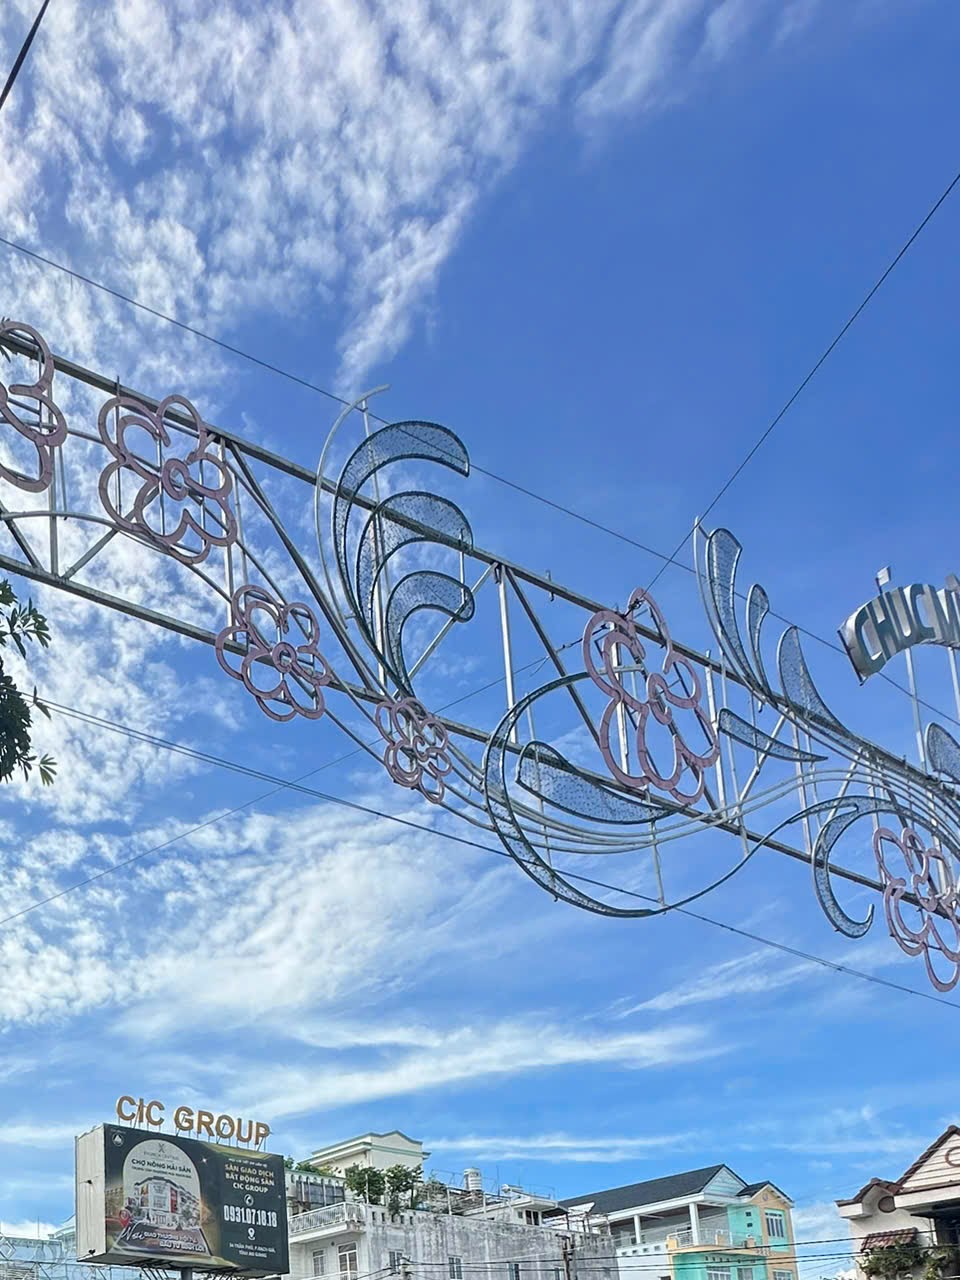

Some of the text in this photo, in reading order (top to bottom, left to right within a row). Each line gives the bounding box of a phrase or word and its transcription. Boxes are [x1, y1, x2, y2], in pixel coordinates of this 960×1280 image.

[116, 1095, 271, 1146] CIC GROUP
[240, 1166, 257, 1175] GIAO
[233, 1182, 269, 1193] CIC GROUP
